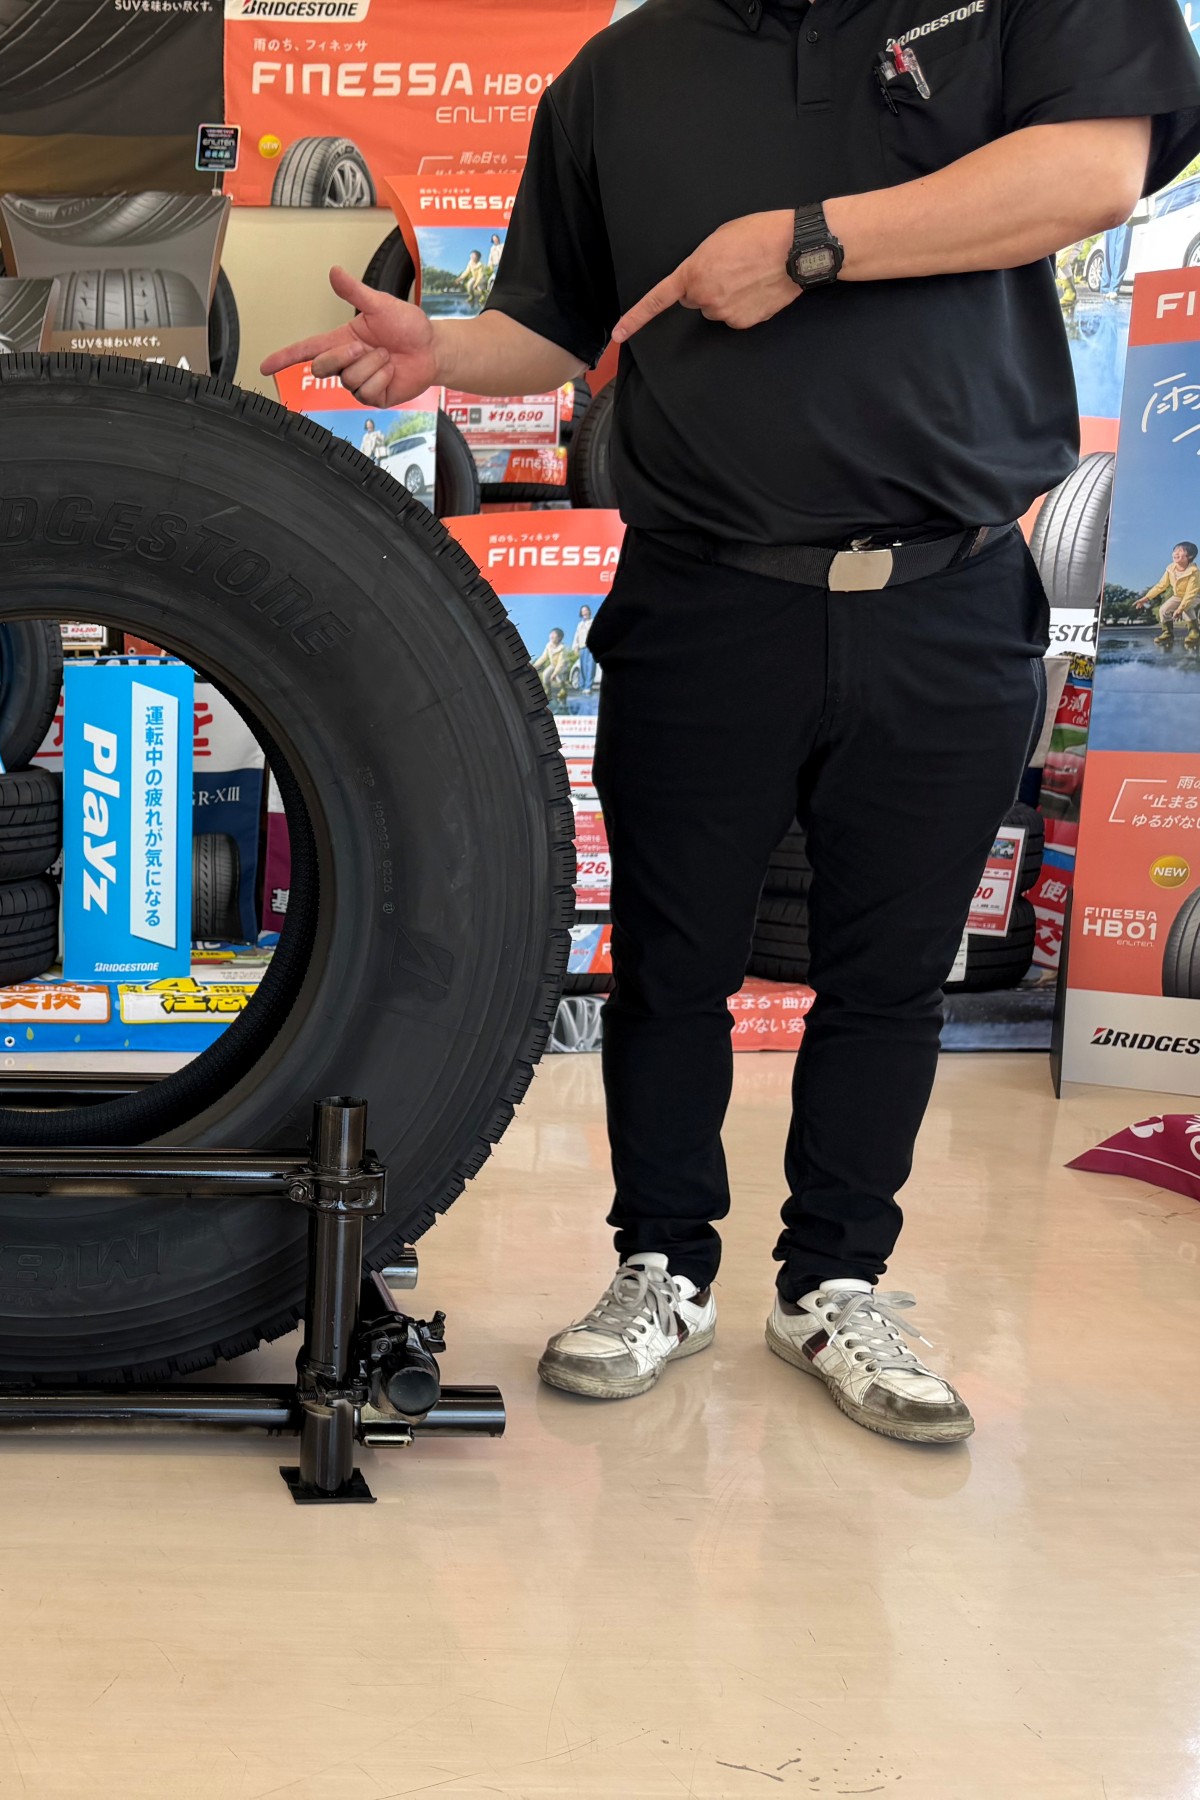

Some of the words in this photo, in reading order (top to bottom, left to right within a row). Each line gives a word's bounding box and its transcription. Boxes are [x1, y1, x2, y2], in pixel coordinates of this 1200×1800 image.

[114, 0, 213, 13] SUVを味わい尽くす。
[241, 0, 359, 18] BRIDGESTONE
[885, 0, 986, 52] BRIDGESTONE
[253, 38, 369, 53] 雨のち、フィネッサ
[251, 61, 474, 96] FINESSA
[459, 151, 508, 165] 雨の日でも
[70, 335, 161, 350] SUVを味わい尽くす。
[489, 410, 544, 423] ¥19,690
[487, 545, 621, 568] FINESSA
[82, 722, 121, 916] Playz
[144, 706, 164, 927] 運転中の疲れが気になる
[1154, 867, 1187, 877] NEW
[1084, 906, 1157, 922] FINESSA
[1082, 919, 1156, 941] HB01
[94, 962, 159, 972] BRIDGESTONE
